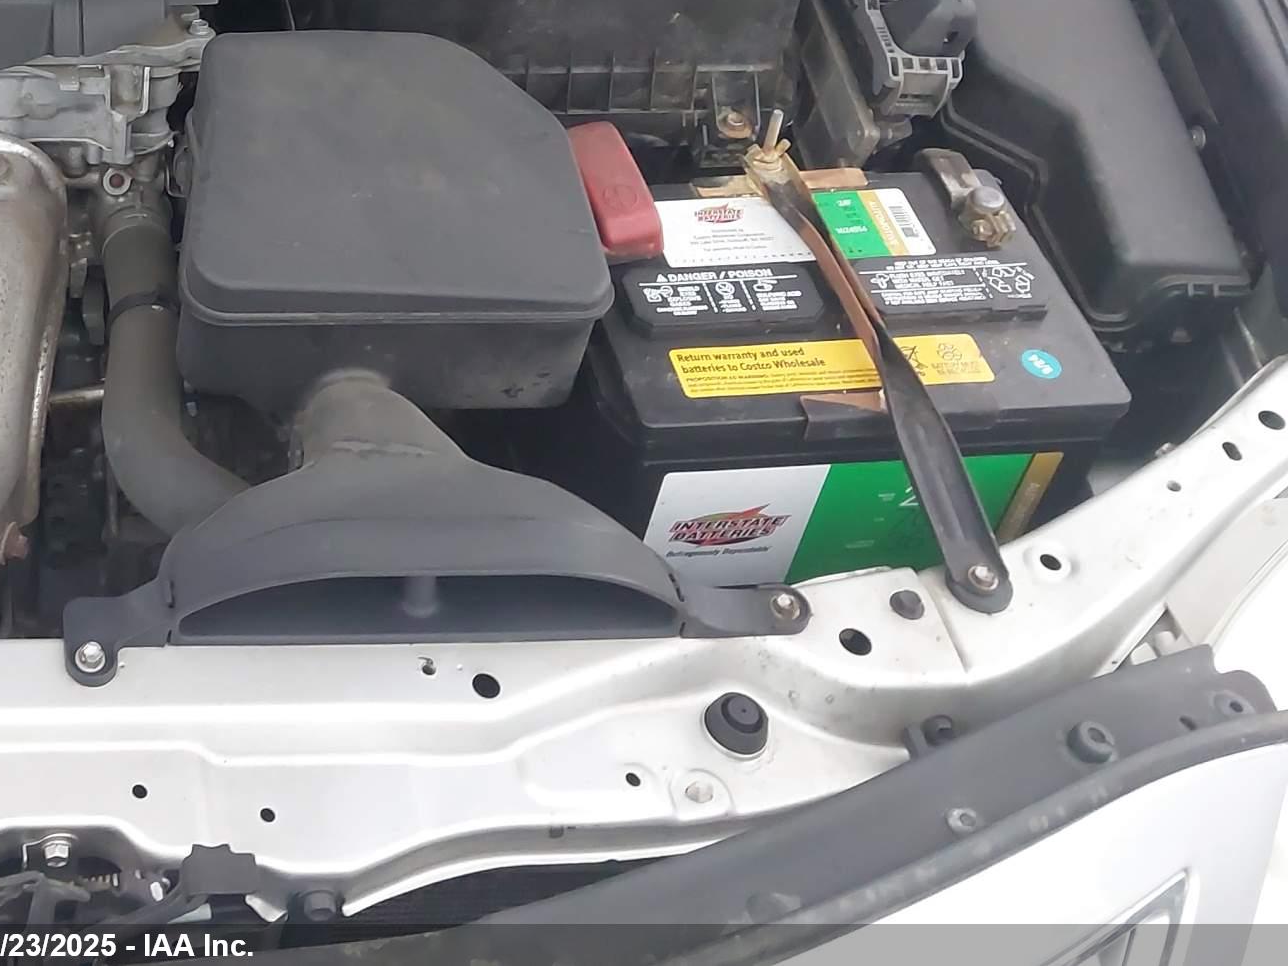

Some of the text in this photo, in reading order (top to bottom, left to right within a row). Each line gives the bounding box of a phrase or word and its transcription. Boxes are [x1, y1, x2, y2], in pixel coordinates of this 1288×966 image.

[668, 268, 774, 282] DANGER / POISON
[677, 347, 805, 362] Return warranty and used
[681, 358, 826, 374] batteries to Costco Wholesale
[674, 516, 781, 531] INTERSTATE
[671, 527, 770, 541] BATTERIES
